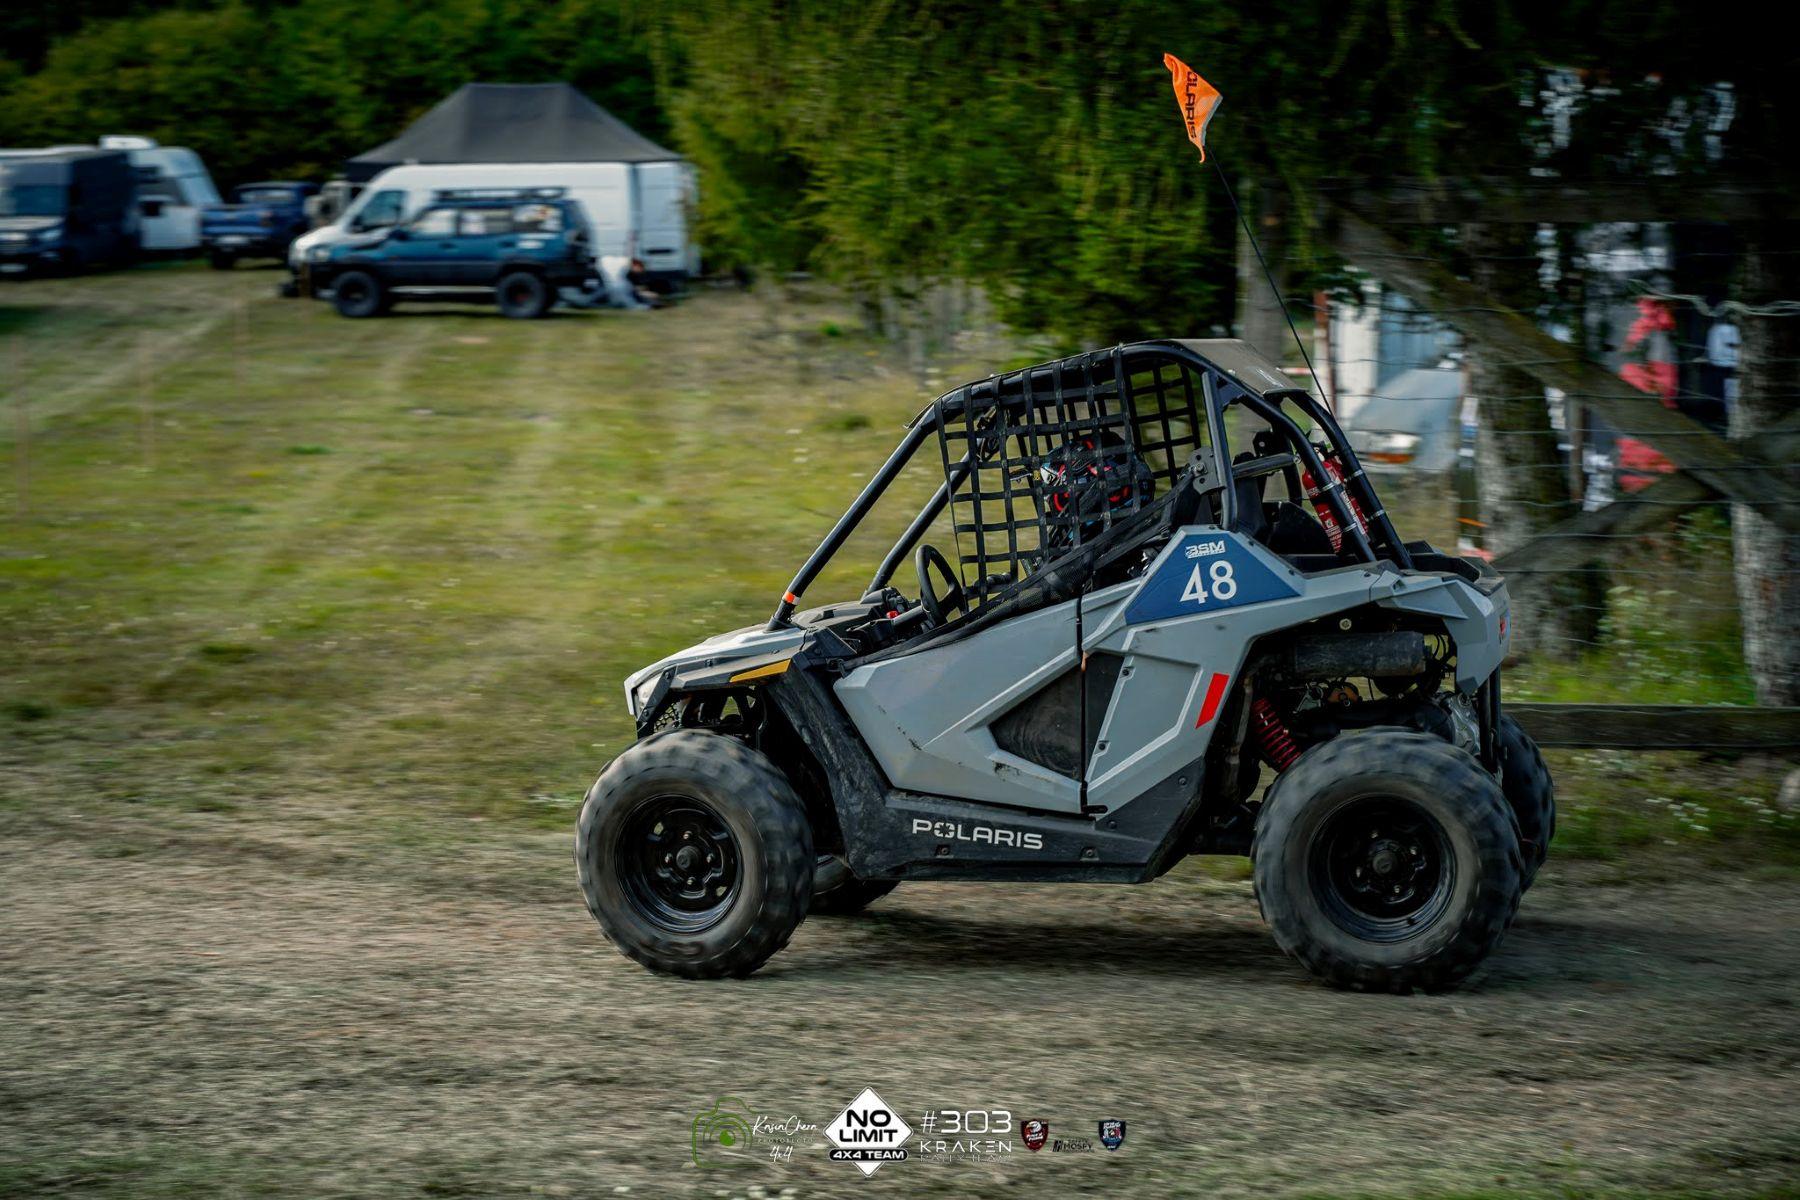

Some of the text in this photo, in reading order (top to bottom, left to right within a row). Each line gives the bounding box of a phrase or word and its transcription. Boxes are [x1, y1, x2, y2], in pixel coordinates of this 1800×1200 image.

[1185, 72, 1198, 138] OLARIS
[1179, 560, 1237, 604] 48
[912, 818, 1044, 850] POLARIS
